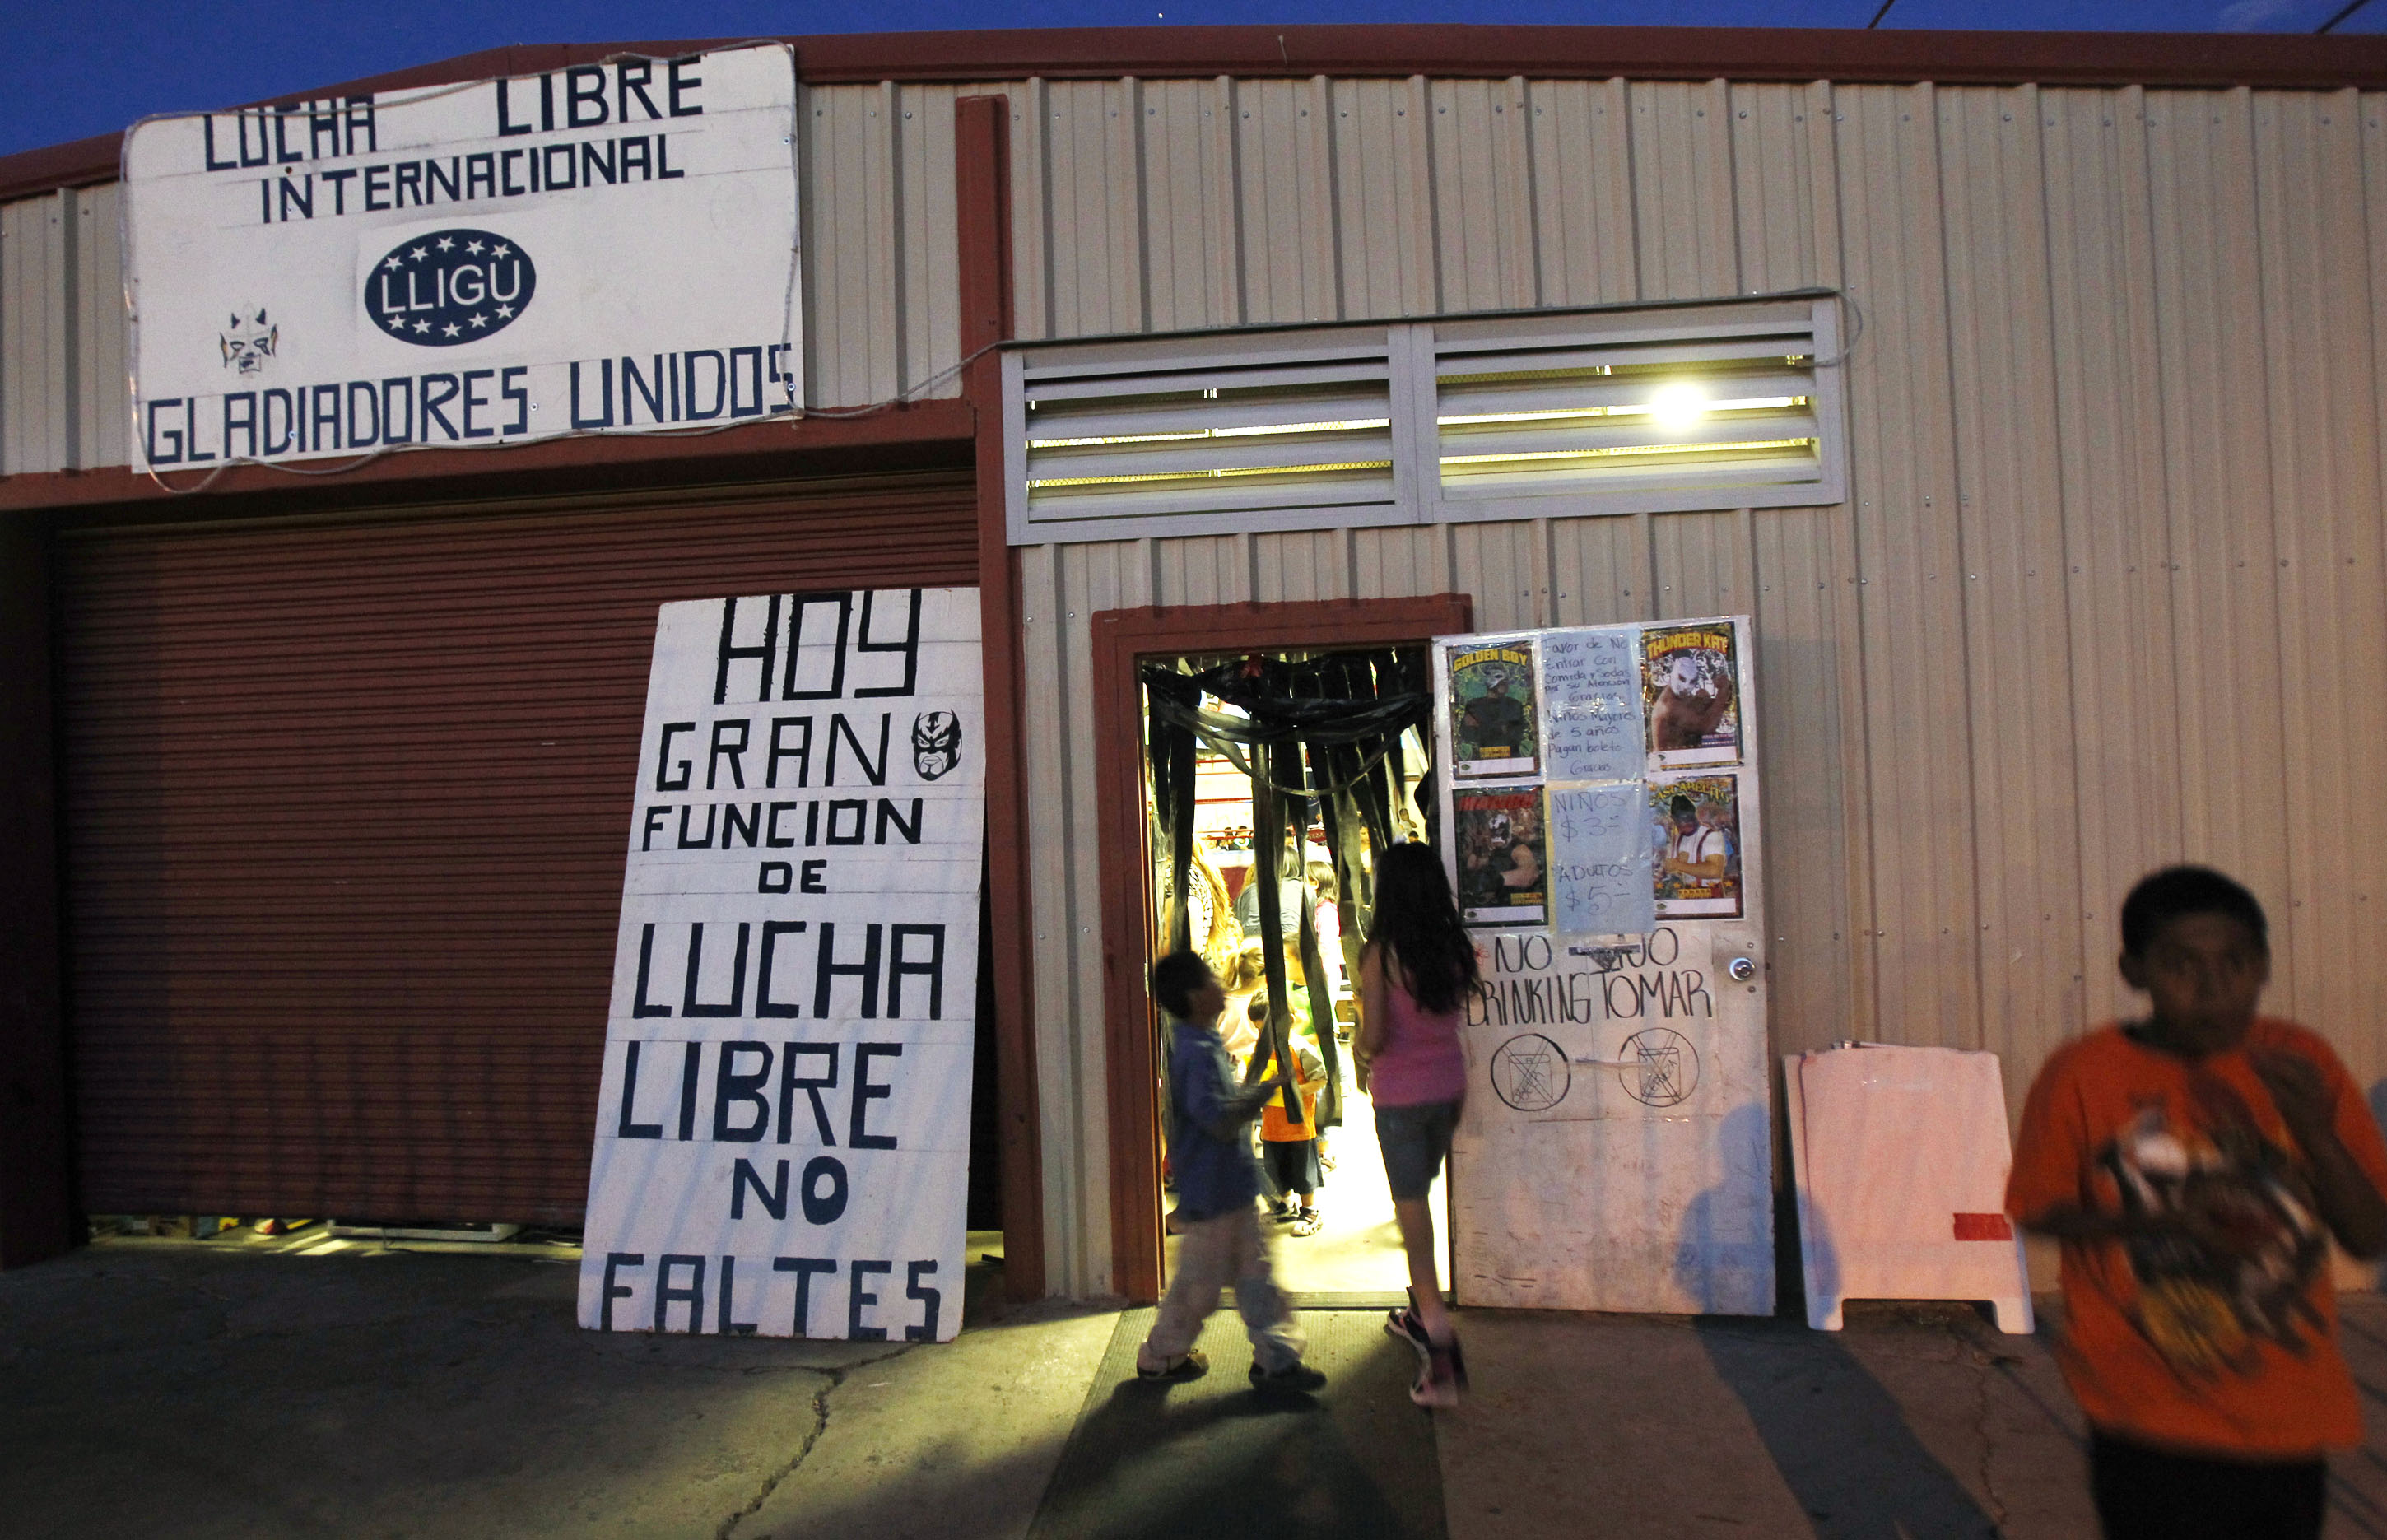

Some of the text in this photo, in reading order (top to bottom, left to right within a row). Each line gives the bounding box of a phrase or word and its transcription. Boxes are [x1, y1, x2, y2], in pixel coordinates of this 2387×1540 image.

[204, 54, 703, 171] LUCHA LIBRE
[261, 134, 684, 223] INTERNACIONAL
[381, 259, 522, 314] LLIGU
[148, 343, 793, 464] GLADIADORES UNIDOS
[714, 588, 922, 705] HOY
[1454, 649, 1528, 672] GOLDEN BOY
[1586, 638, 1603, 649] de
[1647, 632, 1701, 660] THUNDER
[656, 712, 891, 792] GRAN
[1570, 727, 1582, 737] 5
[642, 798, 923, 852] FUNCION
[758, 859, 827, 894] DE
[633, 921, 946, 1020] LUCHA
[1495, 934, 1552, 972] NO
[1590, 969, 1712, 1020] TOMAR
[618, 1040, 902, 1150] LIBRE
[731, 1156, 849, 1226] NO
[601, 1253, 941, 1342] FALTES
